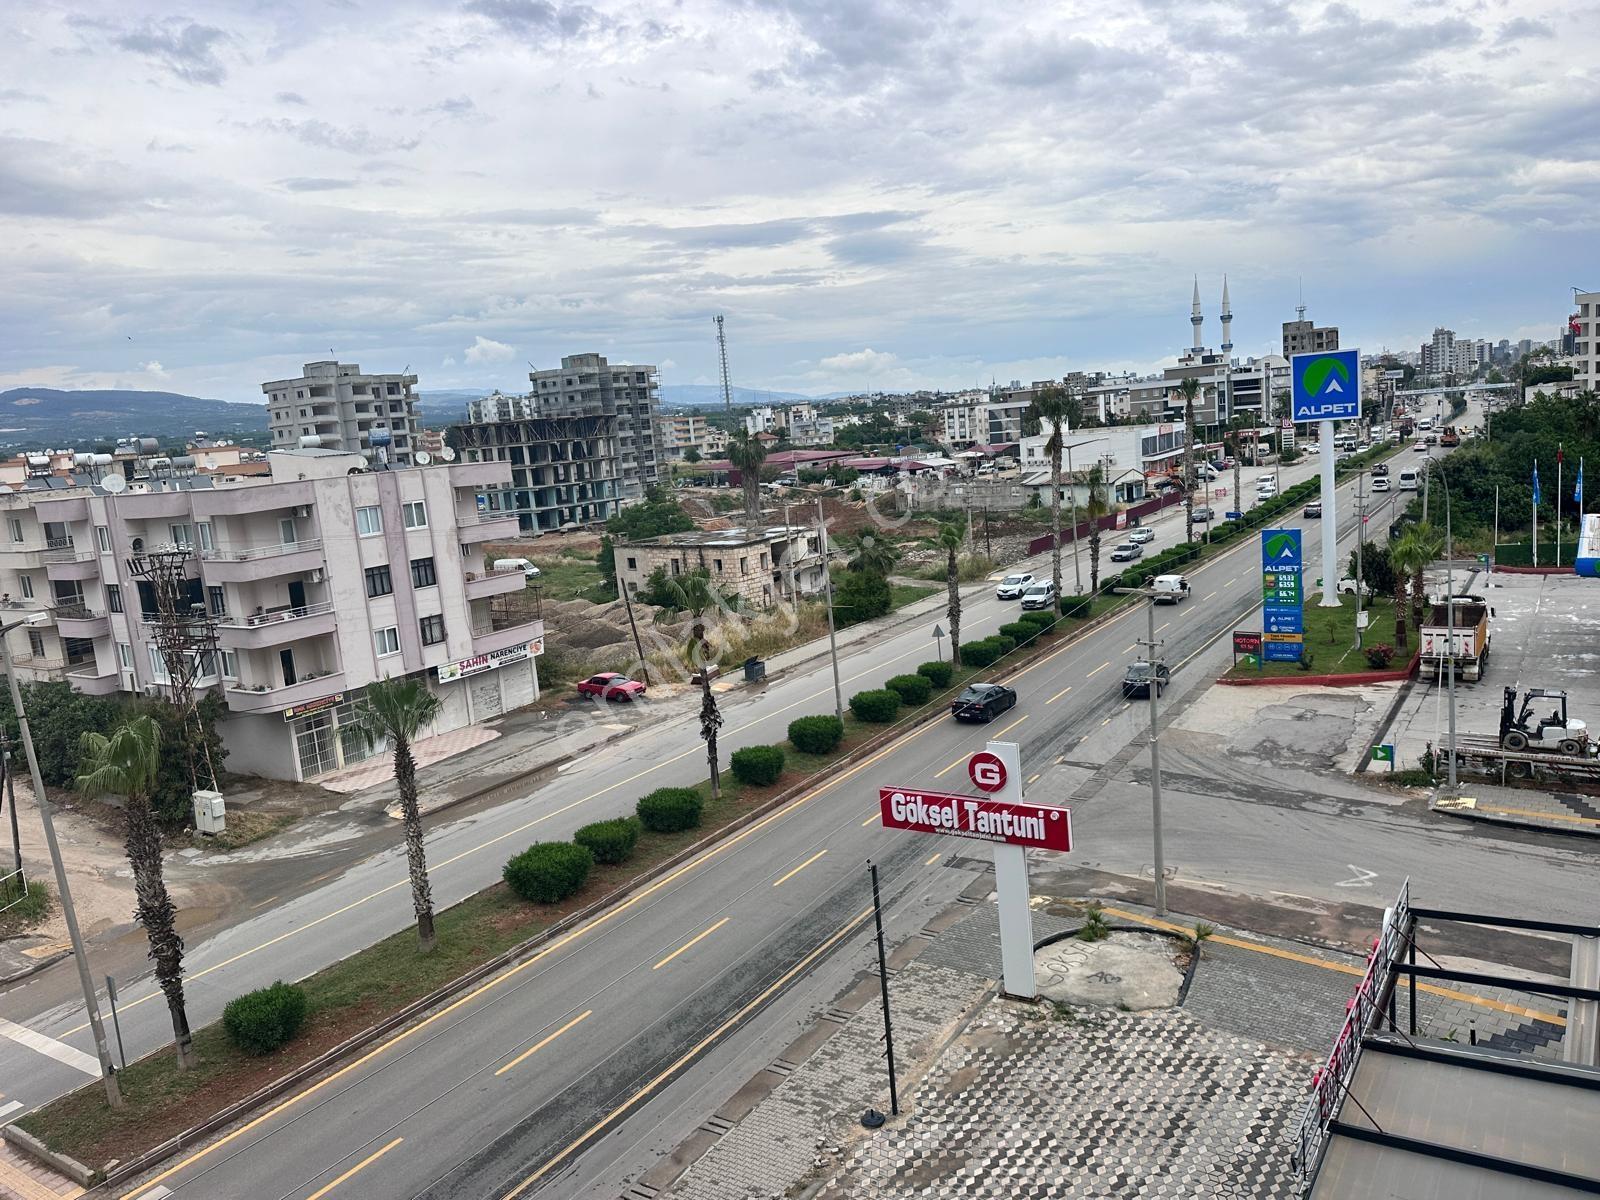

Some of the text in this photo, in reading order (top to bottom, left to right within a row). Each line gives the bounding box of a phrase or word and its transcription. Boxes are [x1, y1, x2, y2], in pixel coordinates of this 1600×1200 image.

[1297, 402, 1356, 416] ALPET
[974, 763, 1000, 785] G
[890, 793, 1046, 841] Göksel Tantuni
